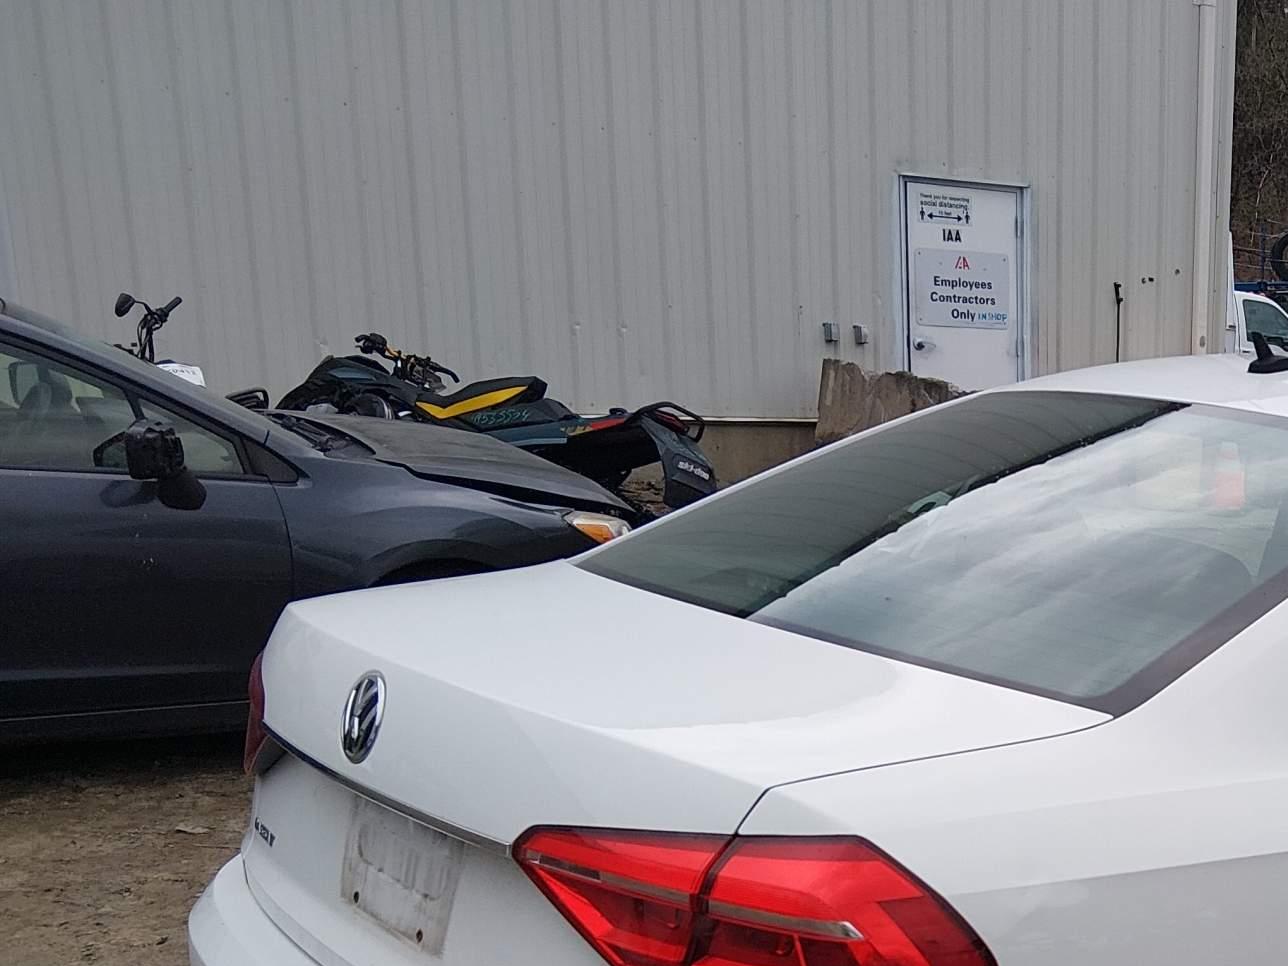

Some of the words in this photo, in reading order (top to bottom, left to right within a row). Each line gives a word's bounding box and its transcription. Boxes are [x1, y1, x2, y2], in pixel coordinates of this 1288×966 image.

[942, 228, 962, 242] IAA
[933, 275, 993, 291] Employees
[930, 291, 996, 306] Contractors
[951, 308, 976, 322] Only
